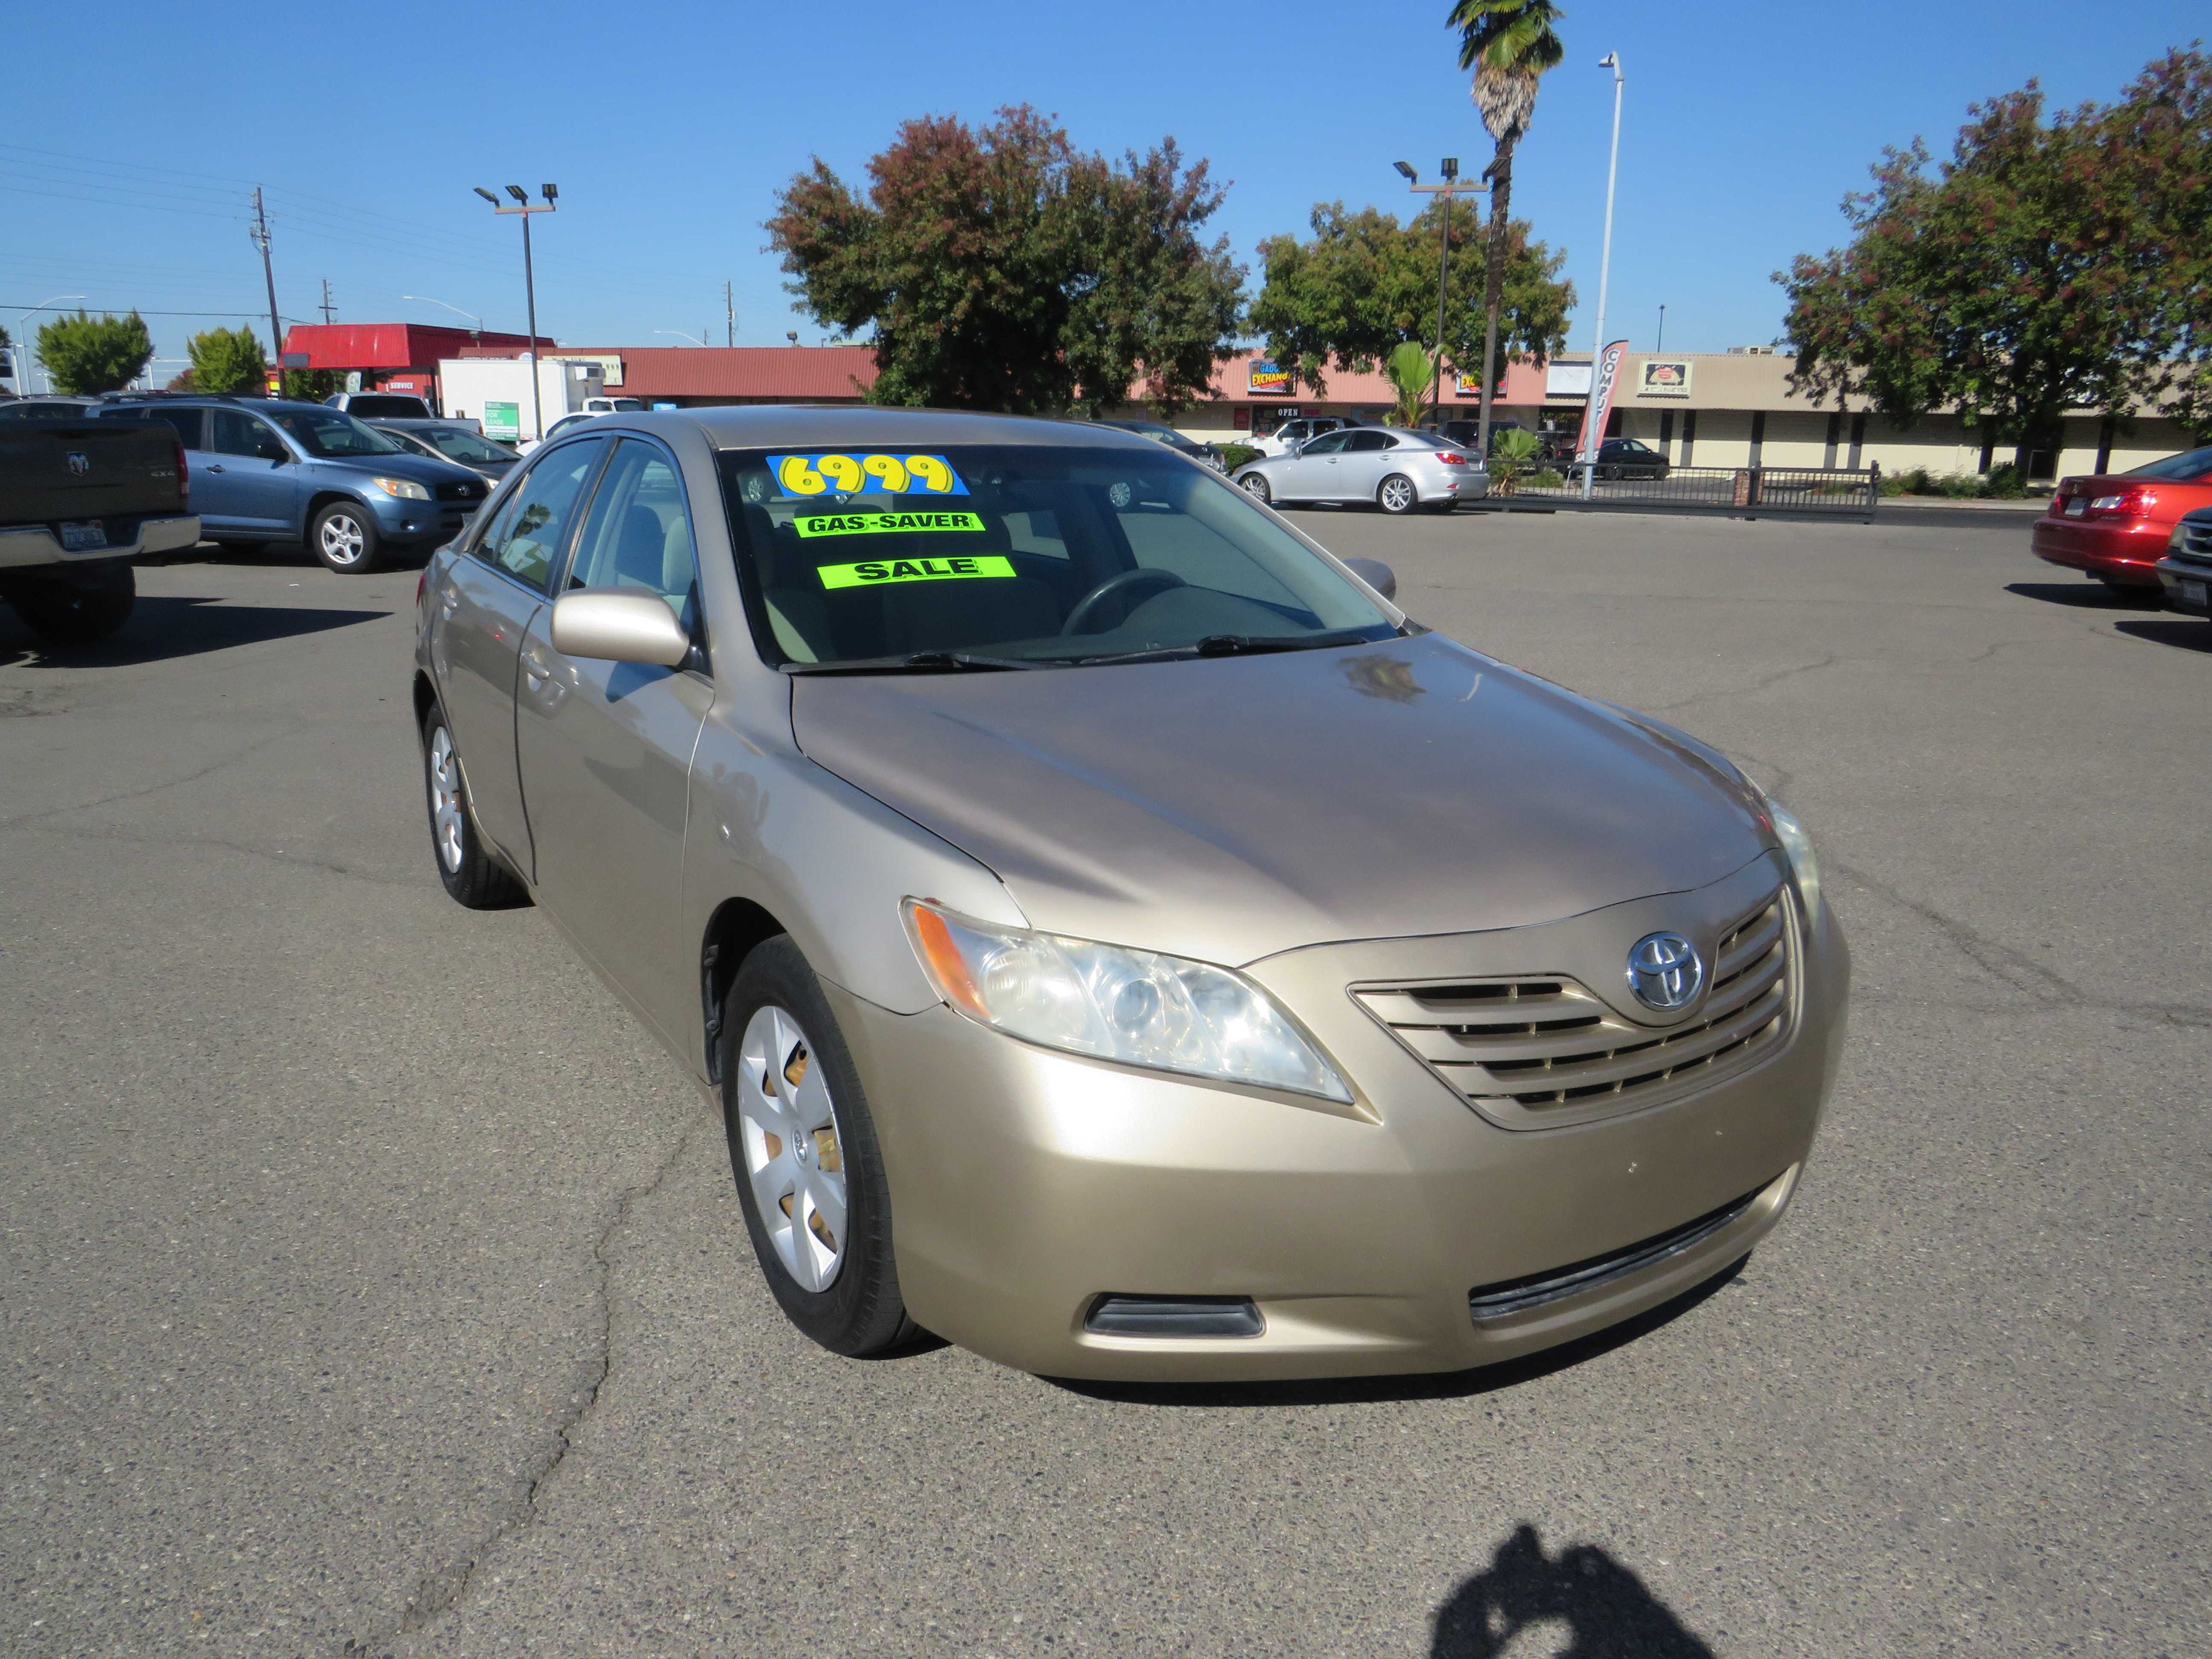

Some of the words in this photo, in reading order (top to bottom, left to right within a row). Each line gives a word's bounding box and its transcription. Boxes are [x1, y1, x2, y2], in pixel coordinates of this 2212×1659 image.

[1251, 371, 1291, 387] EXCHANG
[1278, 408, 1298, 416] OPEN
[779, 454, 954, 495] 6999
[808, 514, 972, 533] GAS-SAVER
[855, 558, 982, 580] SALE
